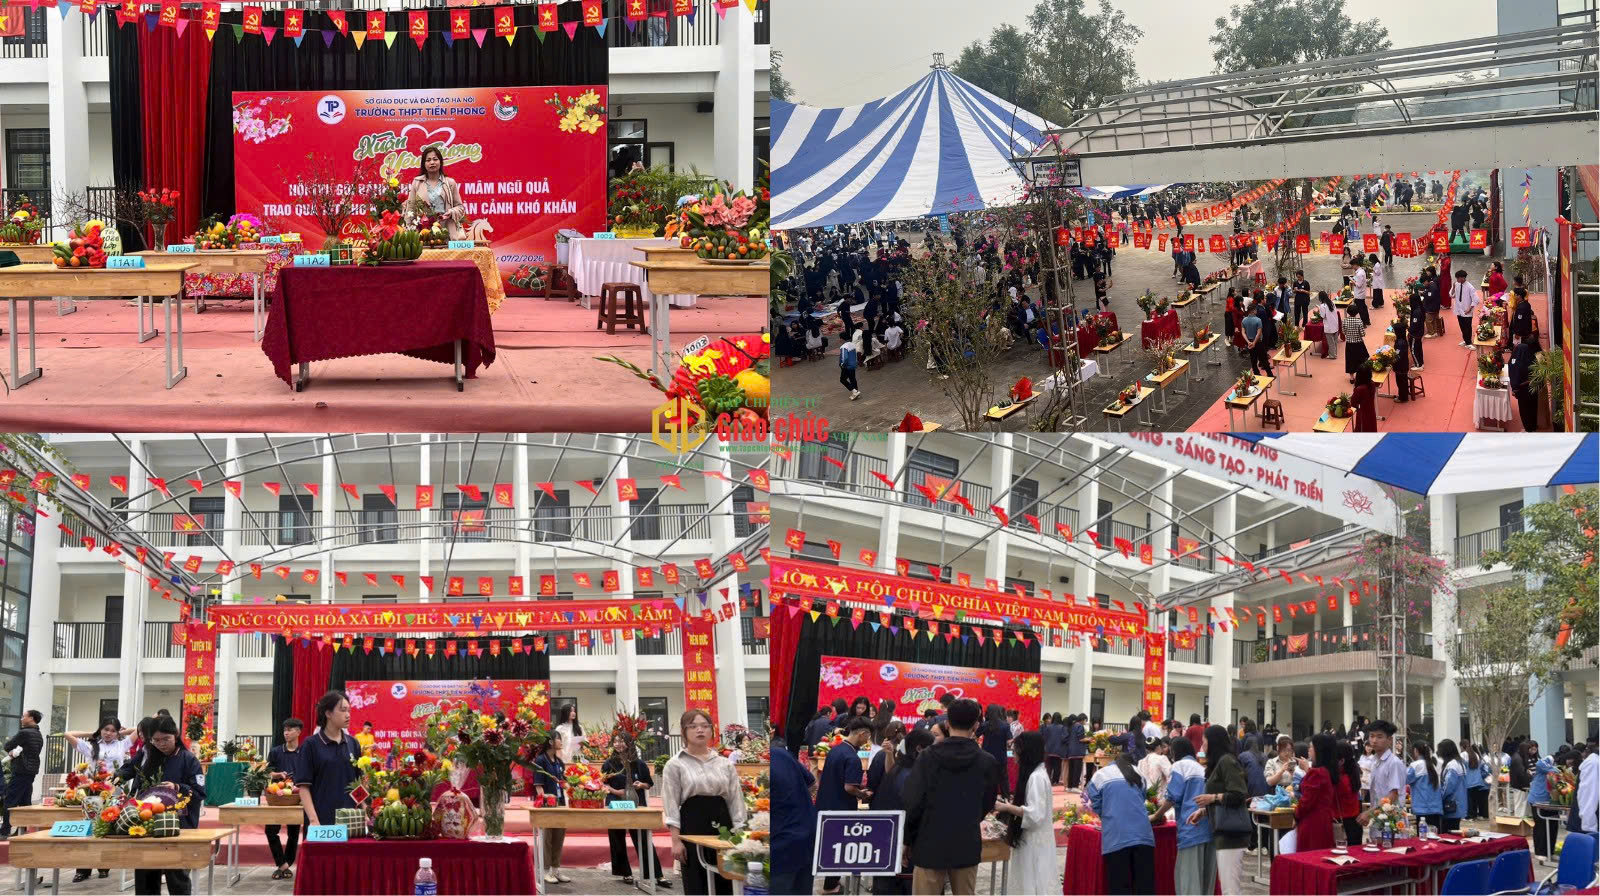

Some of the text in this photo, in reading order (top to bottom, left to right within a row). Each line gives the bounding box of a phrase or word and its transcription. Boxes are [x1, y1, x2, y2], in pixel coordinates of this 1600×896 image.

[355, 106, 396, 117] TRƯỜNG
[398, 107, 424, 116] THPT
[450, 107, 486, 116] PHONG
[464, 180, 495, 195] MÂM
[497, 179, 523, 195] NGŨ
[525, 177, 550, 195] QUẢ
[263, 203, 292, 216] TRAO
[481, 198, 513, 215] CẢNH
[516, 199, 541, 214] KHÓ
[544, 198, 577, 214] KHĂN
[112, 258, 135, 267] 11A1
[300, 257, 325, 266] 11A2
[1175, 436, 1216, 465] SÁNG
[1219, 452, 1246, 476] TẠO
[1257, 467, 1289, 491] PHÁT
[1293, 477, 1324, 502] TRIỂN
[896, 586, 934, 604] CHỦ
[938, 592, 990, 613] NGHĨA
[993, 600, 1031, 620] VIỆT
[1033, 608, 1065, 623] NAM
[1067, 611, 1107, 628] MUÔN
[313, 609, 347, 626] HÒA
[57, 824, 86, 833] 12D5
[314, 829, 342, 839] 12D6
[843, 822, 873, 837] LỚP
[832, 842, 881, 864] 10D1
